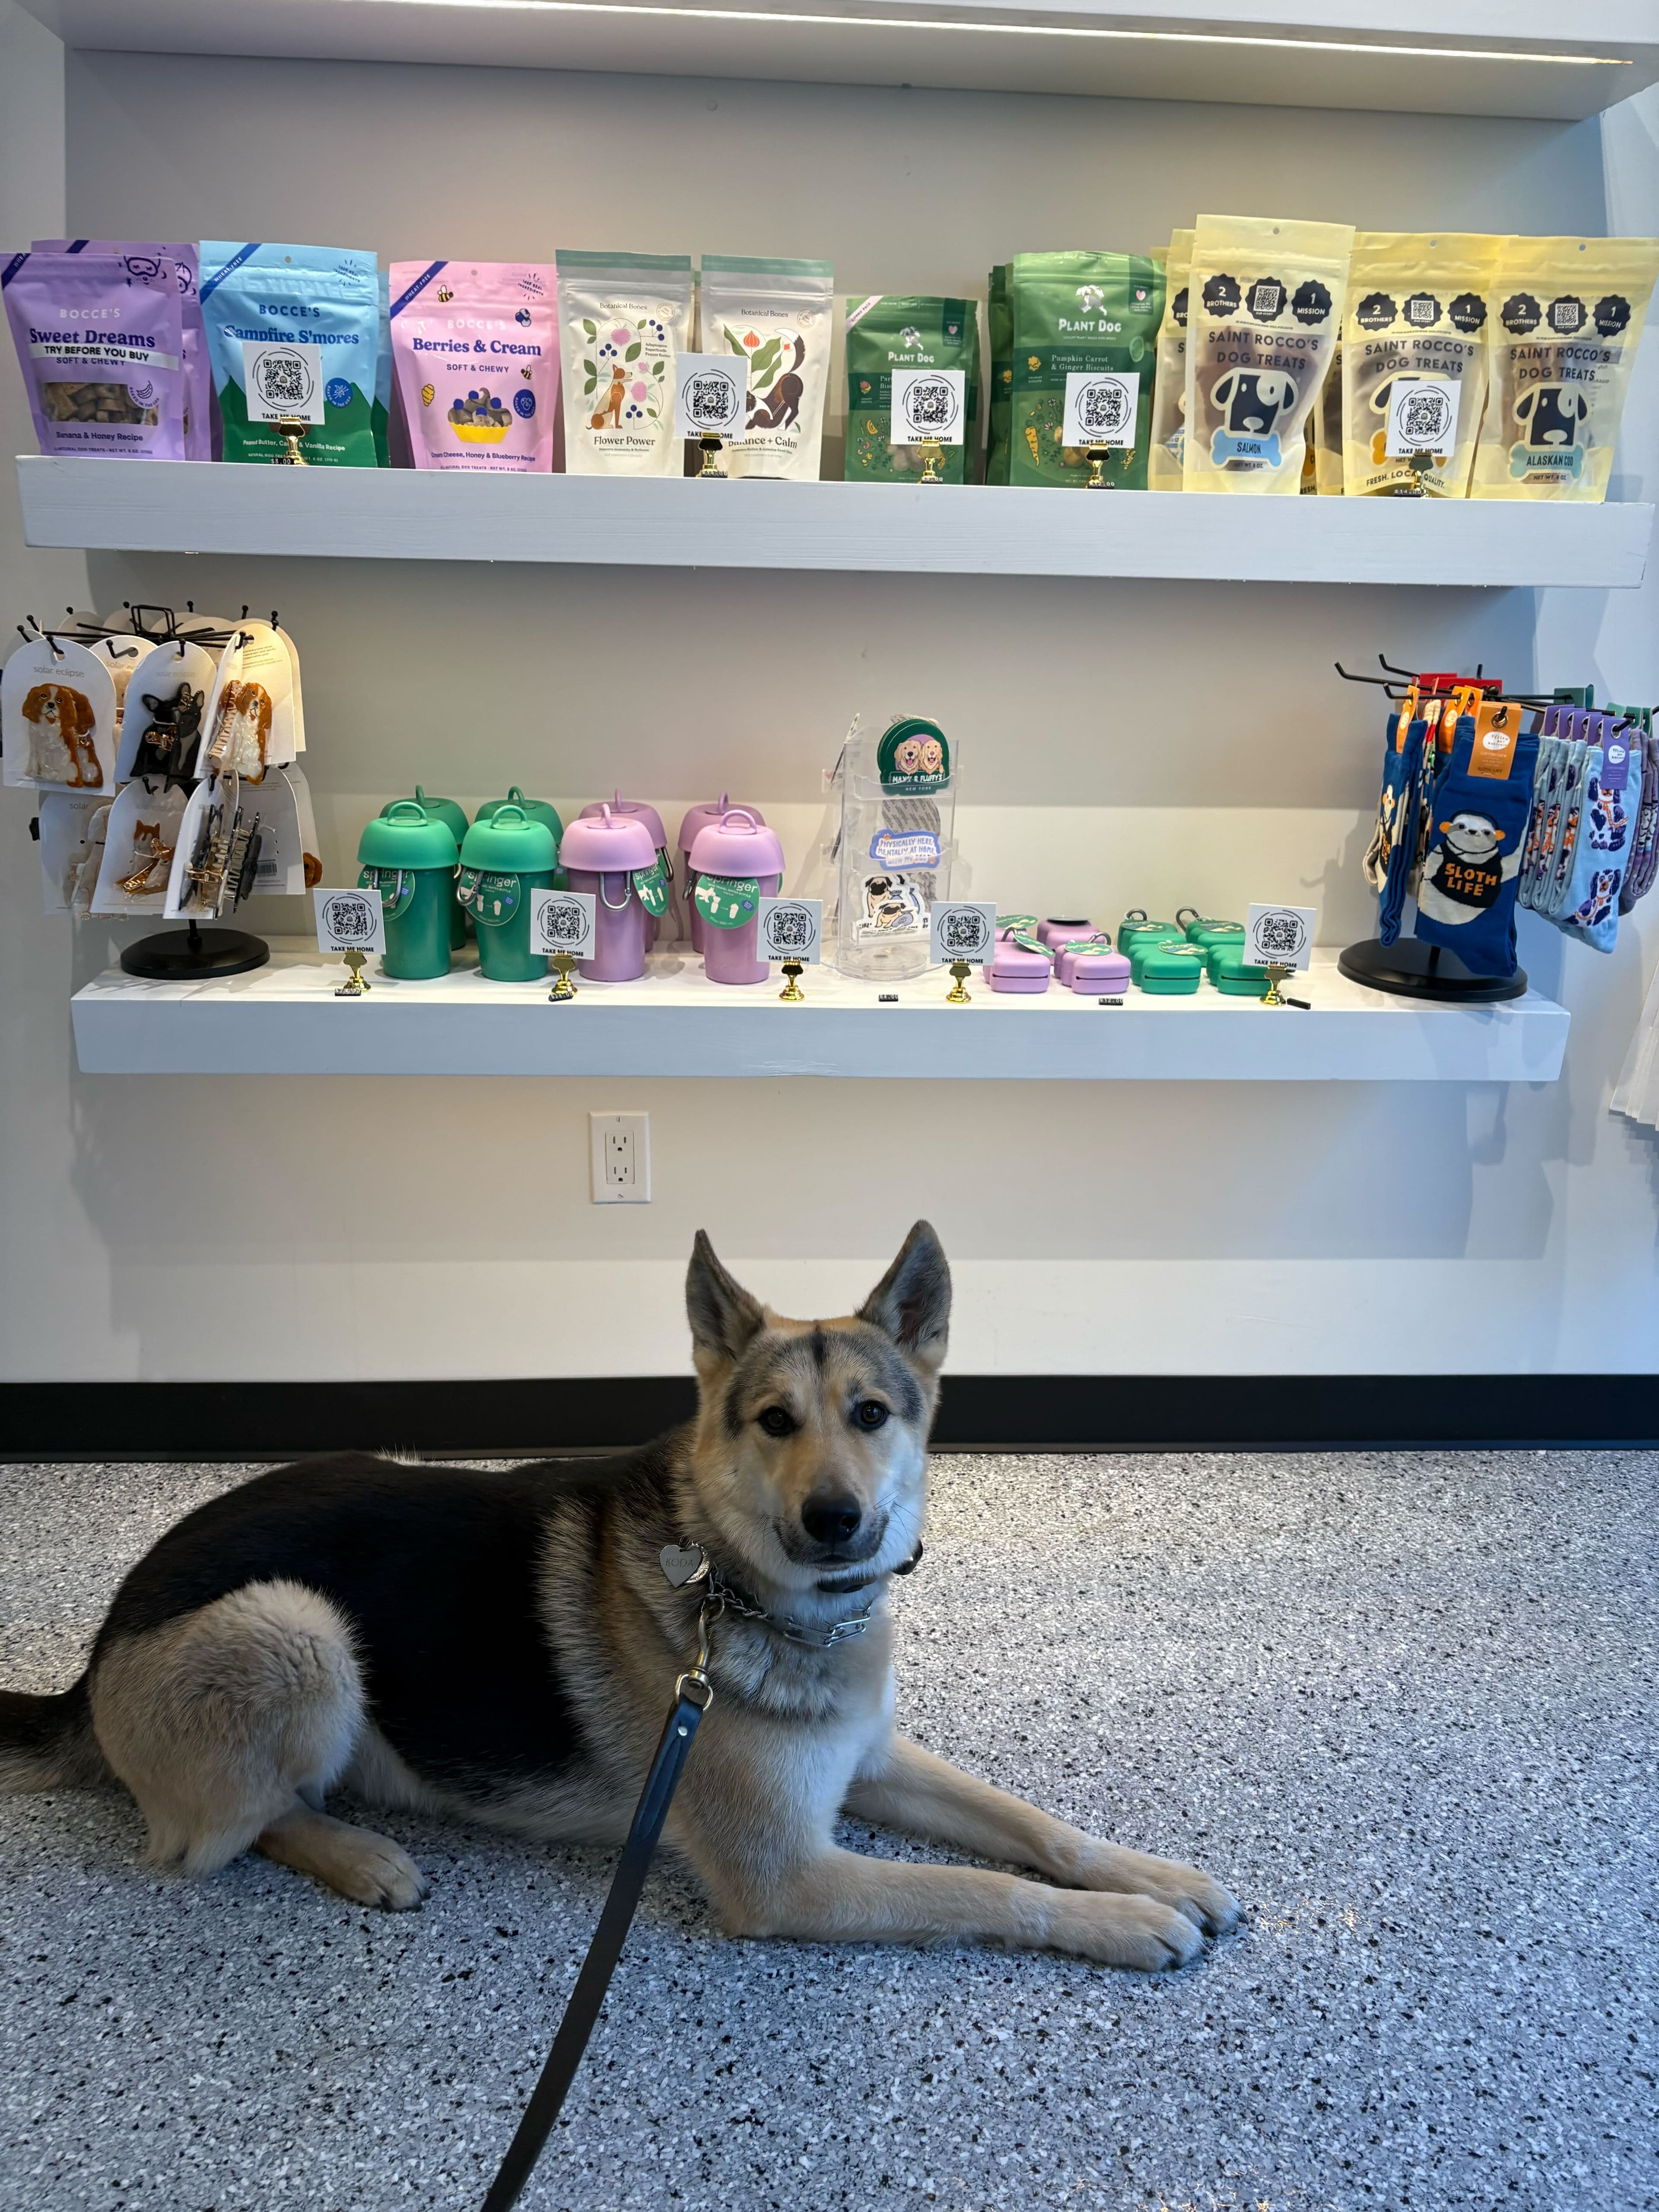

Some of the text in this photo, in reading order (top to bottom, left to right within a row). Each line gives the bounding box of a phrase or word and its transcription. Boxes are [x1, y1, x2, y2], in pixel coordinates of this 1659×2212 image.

[404, 273, 431, 301] WHEAT-FREE
[1218, 286, 1227, 297] 2
[1310, 293, 1317, 304] 1
[60, 308, 121, 319] BOCCE'S
[259, 304, 320, 318] BOCCE'S
[1373, 305, 1381, 315] 2
[1465, 305, 1471, 314] 1
[1518, 305, 1526, 315] 2
[1611, 306, 1616, 317] 1
[447, 319, 506, 331] BOCCE'S
[1455, 315, 1481, 324] MISSION
[1599, 320, 1621, 328] MISSION
[30, 328, 156, 347] Sweet Dreams
[224, 325, 359, 344] Campfire S'mores
[413, 338, 542, 356] Berries & Cream
[1208, 331, 1319, 351] SAINT ROCCO'S
[44, 346, 149, 361] TRY BEFORE YOU BUY
[1365, 340, 1474, 356] SAINT ROCCO'S
[1510, 347, 1611, 362] SAINT ROCCO'S
[1217, 352, 1306, 370] DOG TREATS
[1376, 357, 1463, 373] DOG TREATS
[1519, 367, 1596, 381] DOG TREATS
[91, 432, 115, 441] Honey
[117, 433, 143, 442] Recipe
[594, 436, 656, 446] Flower Power
[775, 437, 798, 449] Calm
[1236, 442, 1261, 454] SALMON
[1526, 455, 1574, 467] ALASKAN COD
[1366, 470, 1445, 489] FRESH. LOCA QUALITY.
[106, 660, 125, 670] solar
[34, 666, 85, 678] solar eclipse
[920, 774, 943, 782] FLUFFY'S
[880, 838, 916, 847] PHYSICALLY
[635, 862, 659, 881] springer
[1445, 863, 1497, 886] SLOTH
[706, 875, 758, 893] springer
[1447, 877, 1484, 896] LIFE
[666, 1558, 693, 1567] KODA
